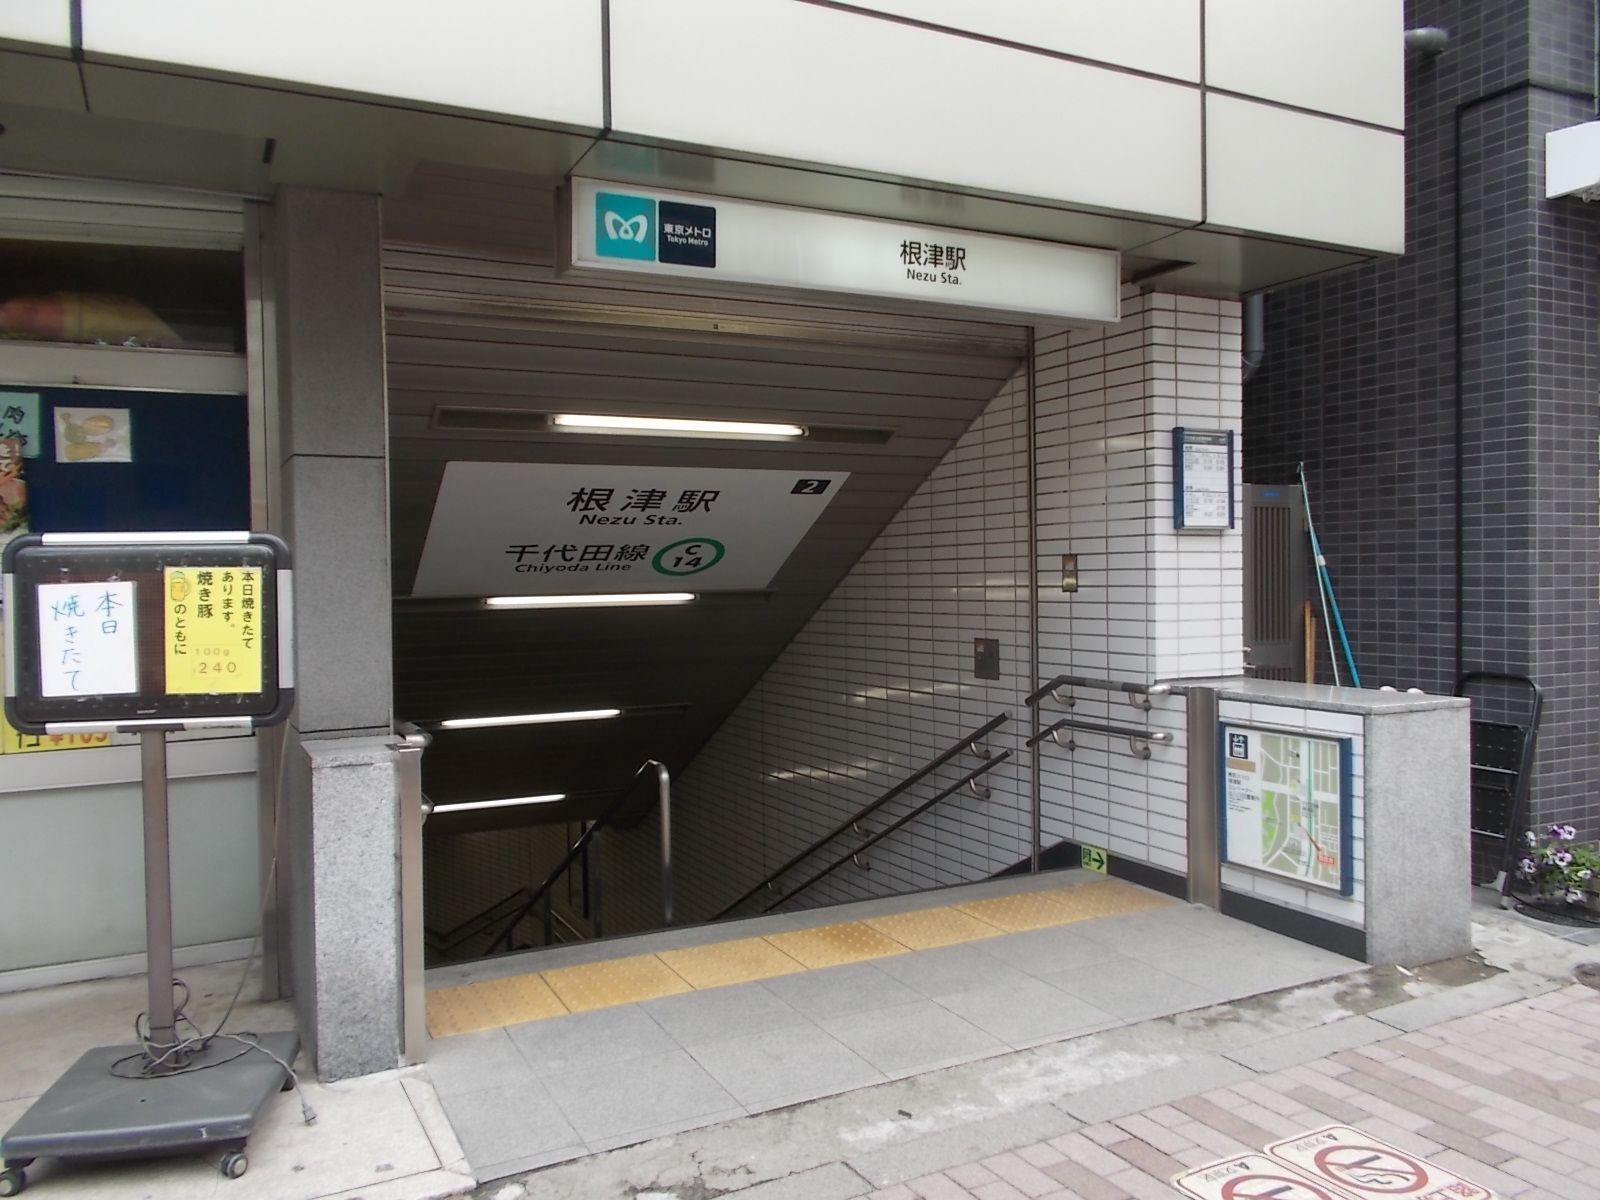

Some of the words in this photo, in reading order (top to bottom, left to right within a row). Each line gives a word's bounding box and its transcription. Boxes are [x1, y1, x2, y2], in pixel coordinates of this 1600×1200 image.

[664, 223, 711, 238] 東京メトロ
[667, 235, 687, 245] Tokyo
[688, 238, 708, 246] Metro
[900, 240, 966, 271] 根津駅
[907, 268, 937, 282] Nezu
[941, 272, 962, 285] Sta.
[801, 480, 816, 493] 2
[567, 487, 720, 513] 根津駅
[579, 514, 636, 526] Nezu
[643, 514, 683, 526] Sta.
[505, 544, 650, 563] 千代田線
[684, 545, 702, 556] C
[515, 562, 589, 574] Chiyoda
[595, 561, 632, 572] Line
[672, 557, 702, 569] 14
[197, 571, 213, 619] 焼き豚
[222, 571, 236, 628] あります。
[95, 590, 124, 634] 本日
[241, 572, 255, 649] 本日焼きたて
[174, 604, 187, 655] のともに
[50, 595, 86, 691] 焼きたて
